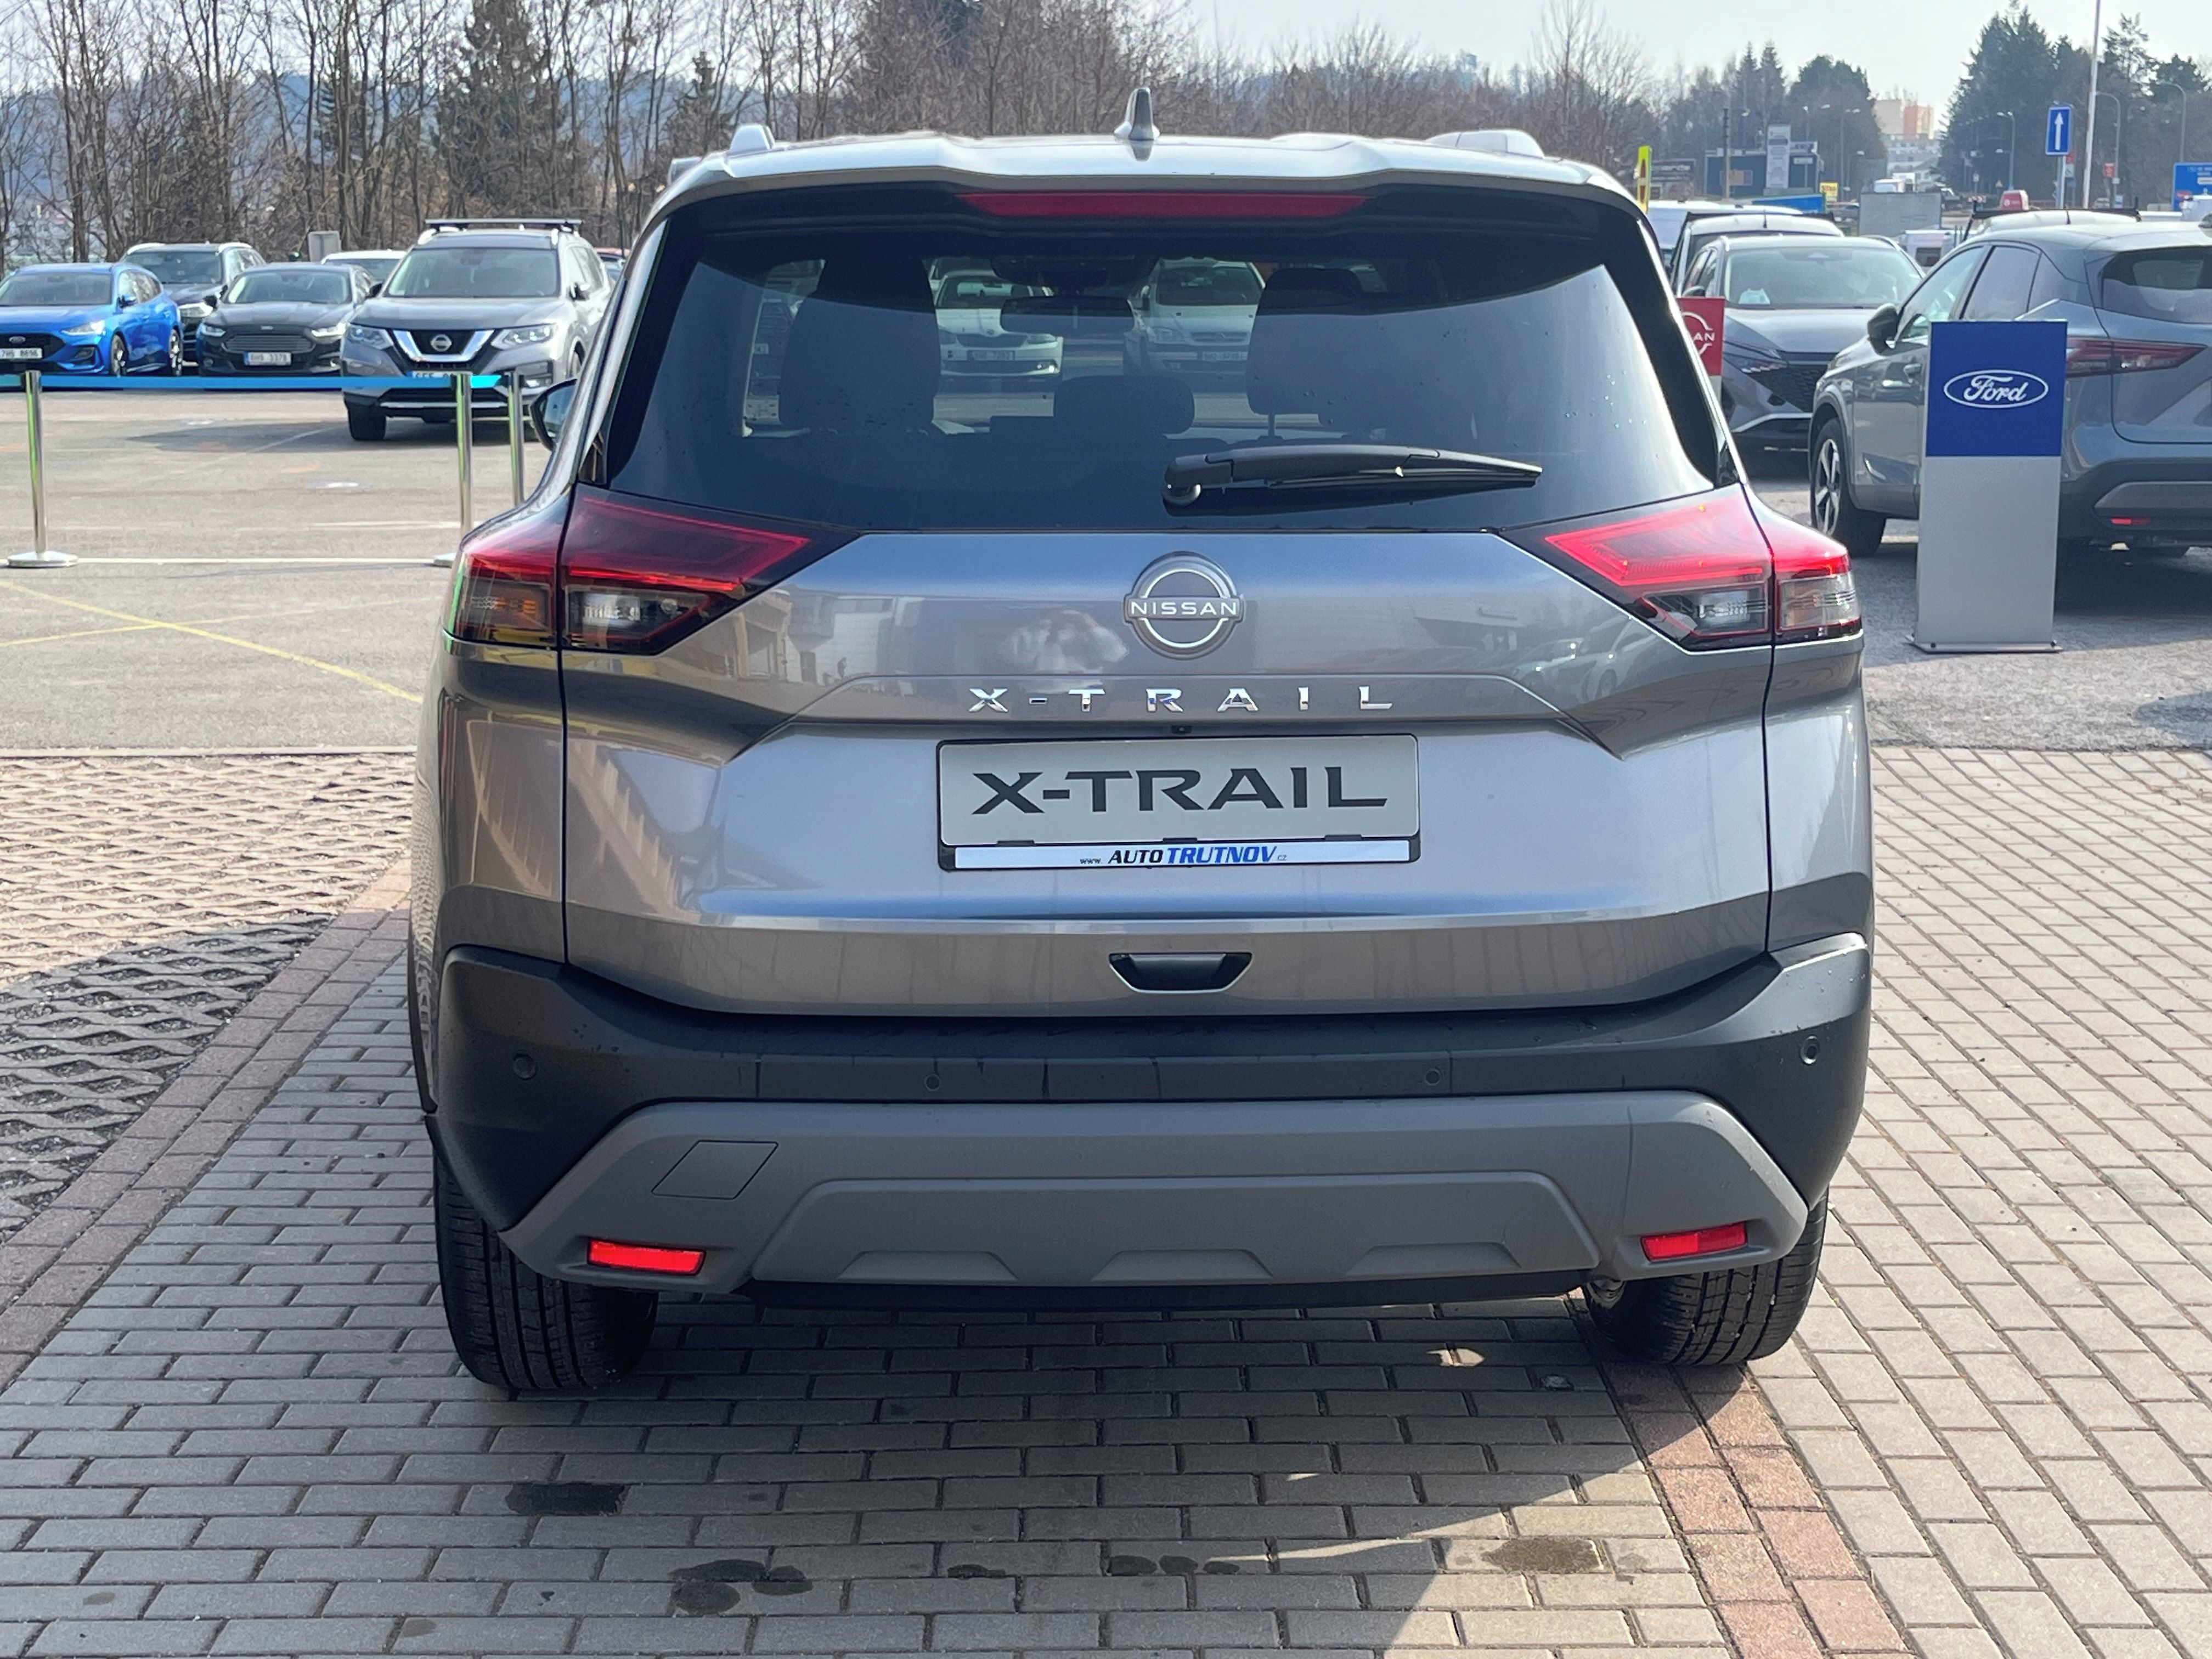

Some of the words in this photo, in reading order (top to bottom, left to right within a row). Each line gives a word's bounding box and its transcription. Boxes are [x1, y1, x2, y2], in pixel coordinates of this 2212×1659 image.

[1963, 375, 2029, 401] Ford
[1131, 602, 1236, 615] NISSAN
[969, 686, 1393, 713] X-TRAIL
[972, 767, 1388, 815] X-TRAIL
